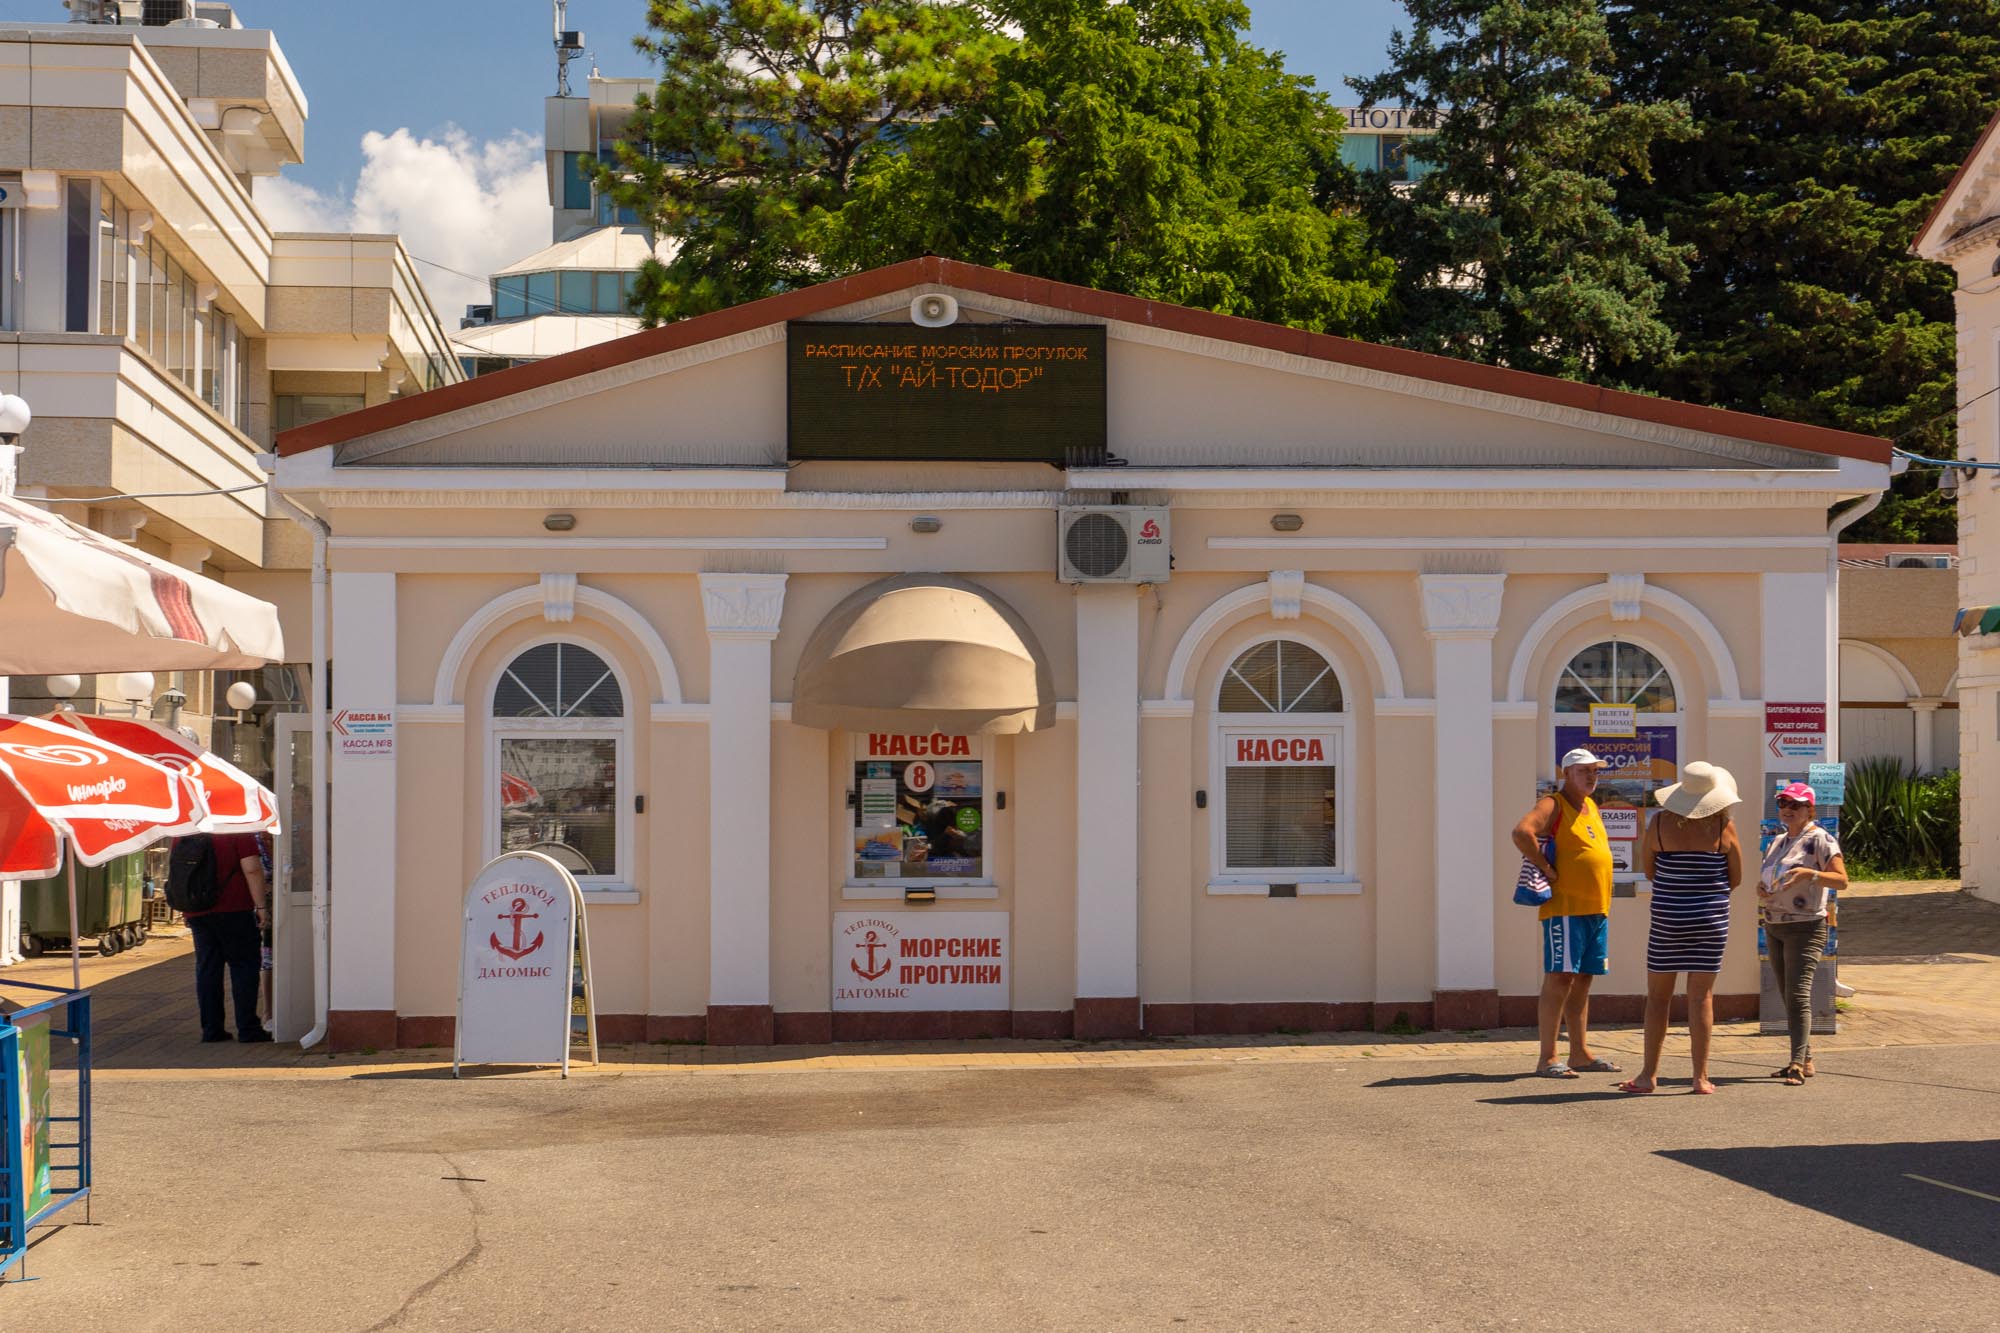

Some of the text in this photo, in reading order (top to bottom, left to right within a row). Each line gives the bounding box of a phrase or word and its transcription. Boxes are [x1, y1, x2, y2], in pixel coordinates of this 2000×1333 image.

[805, 344, 1088, 360] РАСПИСАНИЕ МОРСКИХ ПРОГУЛОК
[841, 360, 1044, 393] Т/Х "АЙ-ТОДОР"
[348, 713, 376, 722] КАССА
[1766, 706, 1826, 714] БИЛЕТНЫЕ КАССЫ
[1773, 722, 1819, 730] TICKET OFFICE
[343, 739, 393, 748] КАССА №8
[869, 732, 970, 756] КАССА
[1782, 736, 1808, 745] КАССА
[1237, 738, 1324, 762] КАССА
[1596, 754, 1651, 768] ССА 4
[913, 765, 926, 788] 8
[1601, 811, 1637, 821] БХАЗИЯ
[481, 884, 556, 907] ТЕПЛОХОД
[844, 919, 899, 937] ТЕПЛОХОД
[900, 938, 1001, 958] МОРСКИЕ
[1553, 923, 1564, 964] ITALIA
[478, 966, 552, 979] ДАГОМЫС
[900, 965, 1001, 985] ПРОГУЛКИ
[836, 988, 910, 1000] ДАГОМЫС
